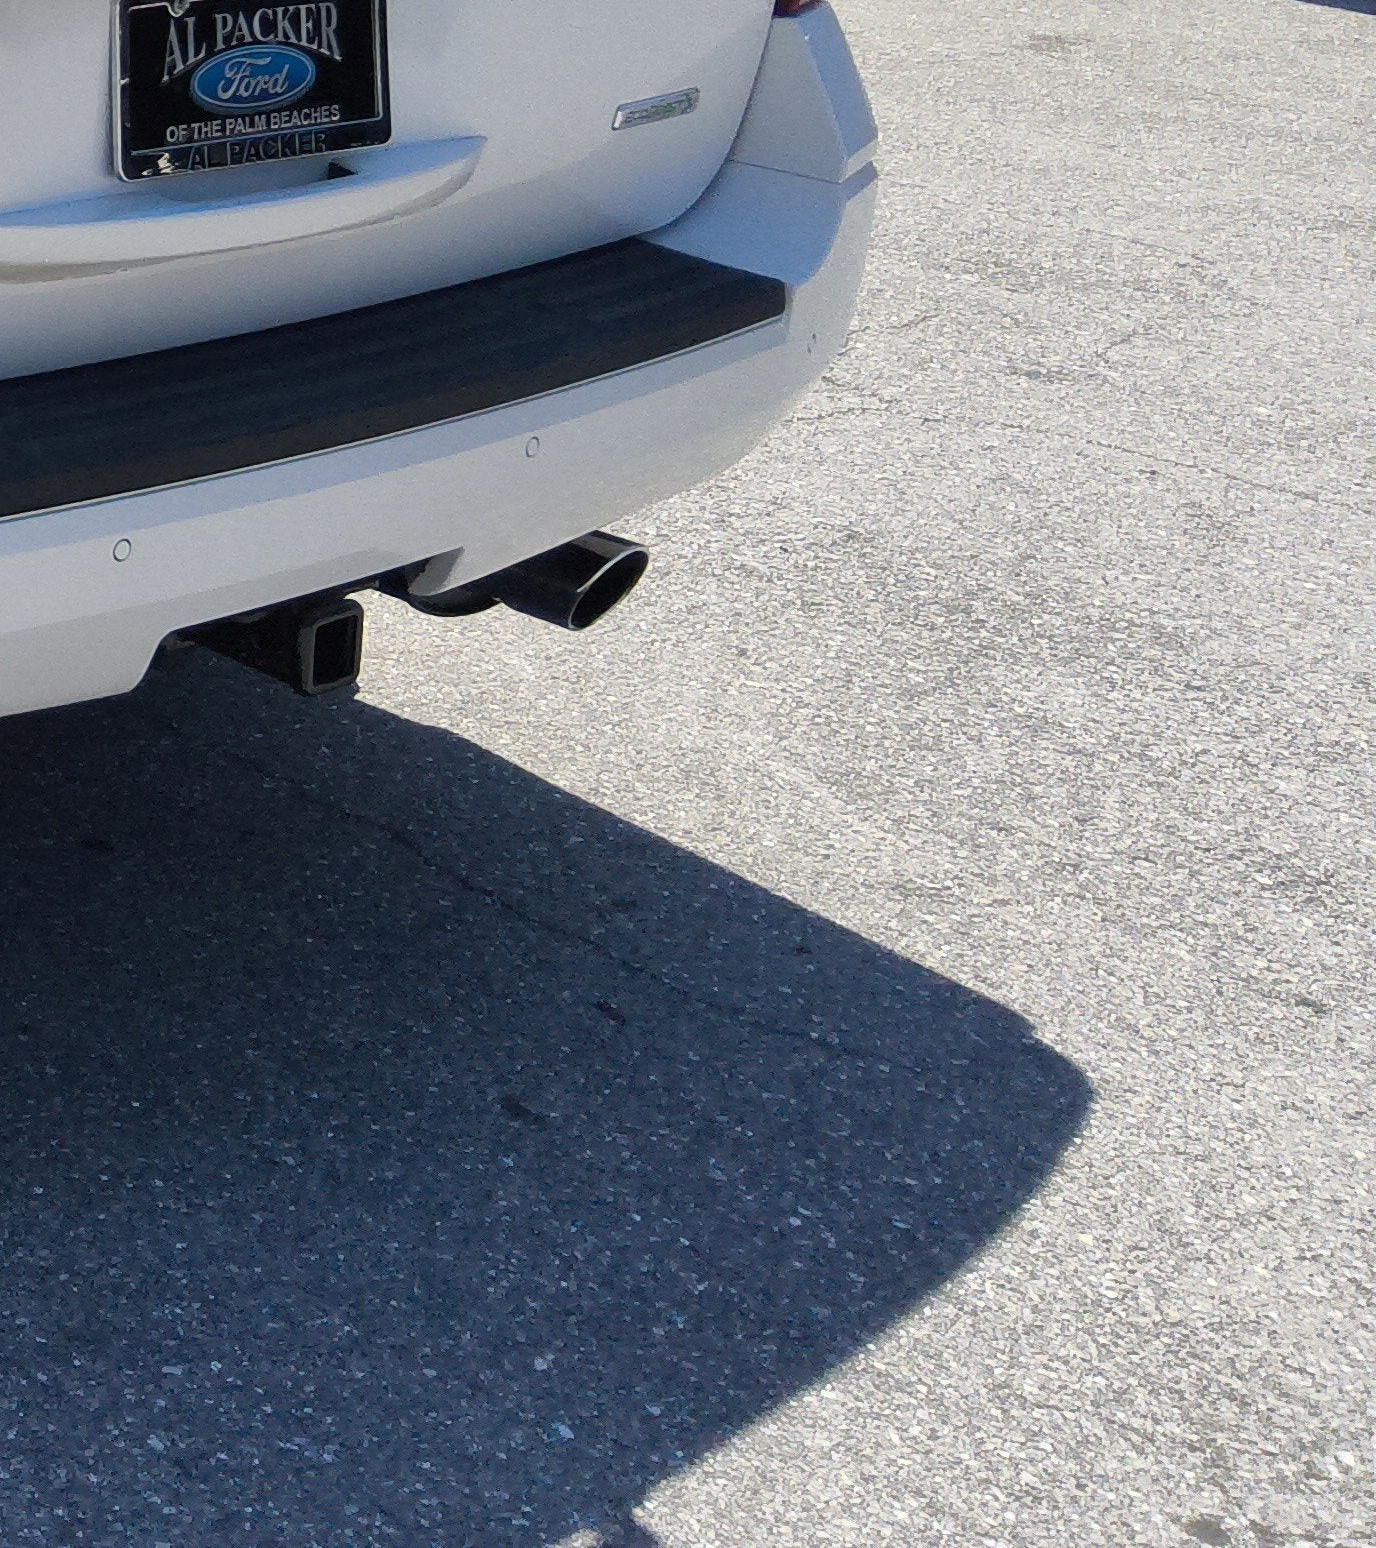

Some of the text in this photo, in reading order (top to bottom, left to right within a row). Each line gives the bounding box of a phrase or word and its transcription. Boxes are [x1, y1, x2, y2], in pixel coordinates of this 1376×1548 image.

[160, 1, 343, 87] AL PACKER
[217, 56, 290, 100] Ford
[166, 105, 340, 143] OF THE PALM BEACHES
